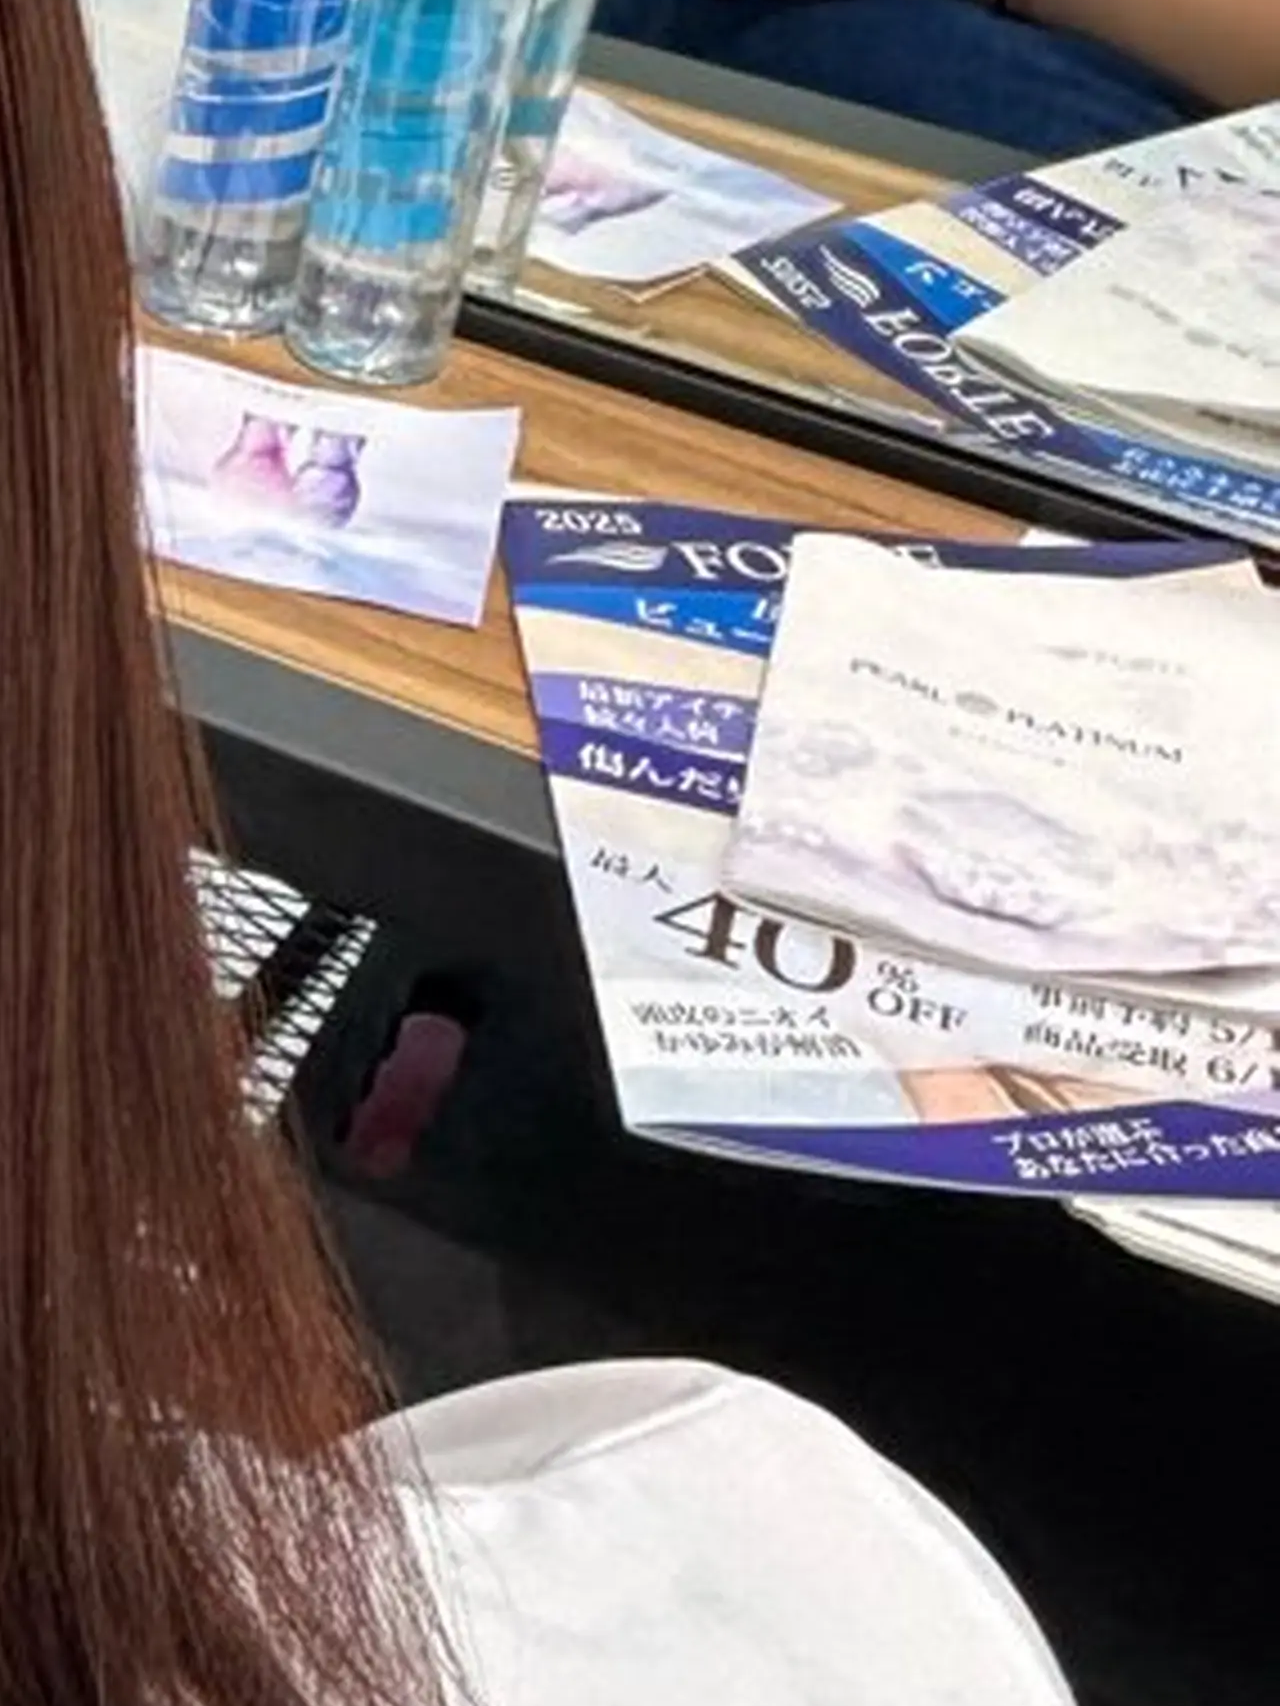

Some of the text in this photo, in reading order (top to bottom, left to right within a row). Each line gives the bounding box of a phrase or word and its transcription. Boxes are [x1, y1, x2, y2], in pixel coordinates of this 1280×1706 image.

[535, 509, 643, 535] 2025
[652, 891, 858, 993] 40
[867, 986, 969, 1031] OFF
